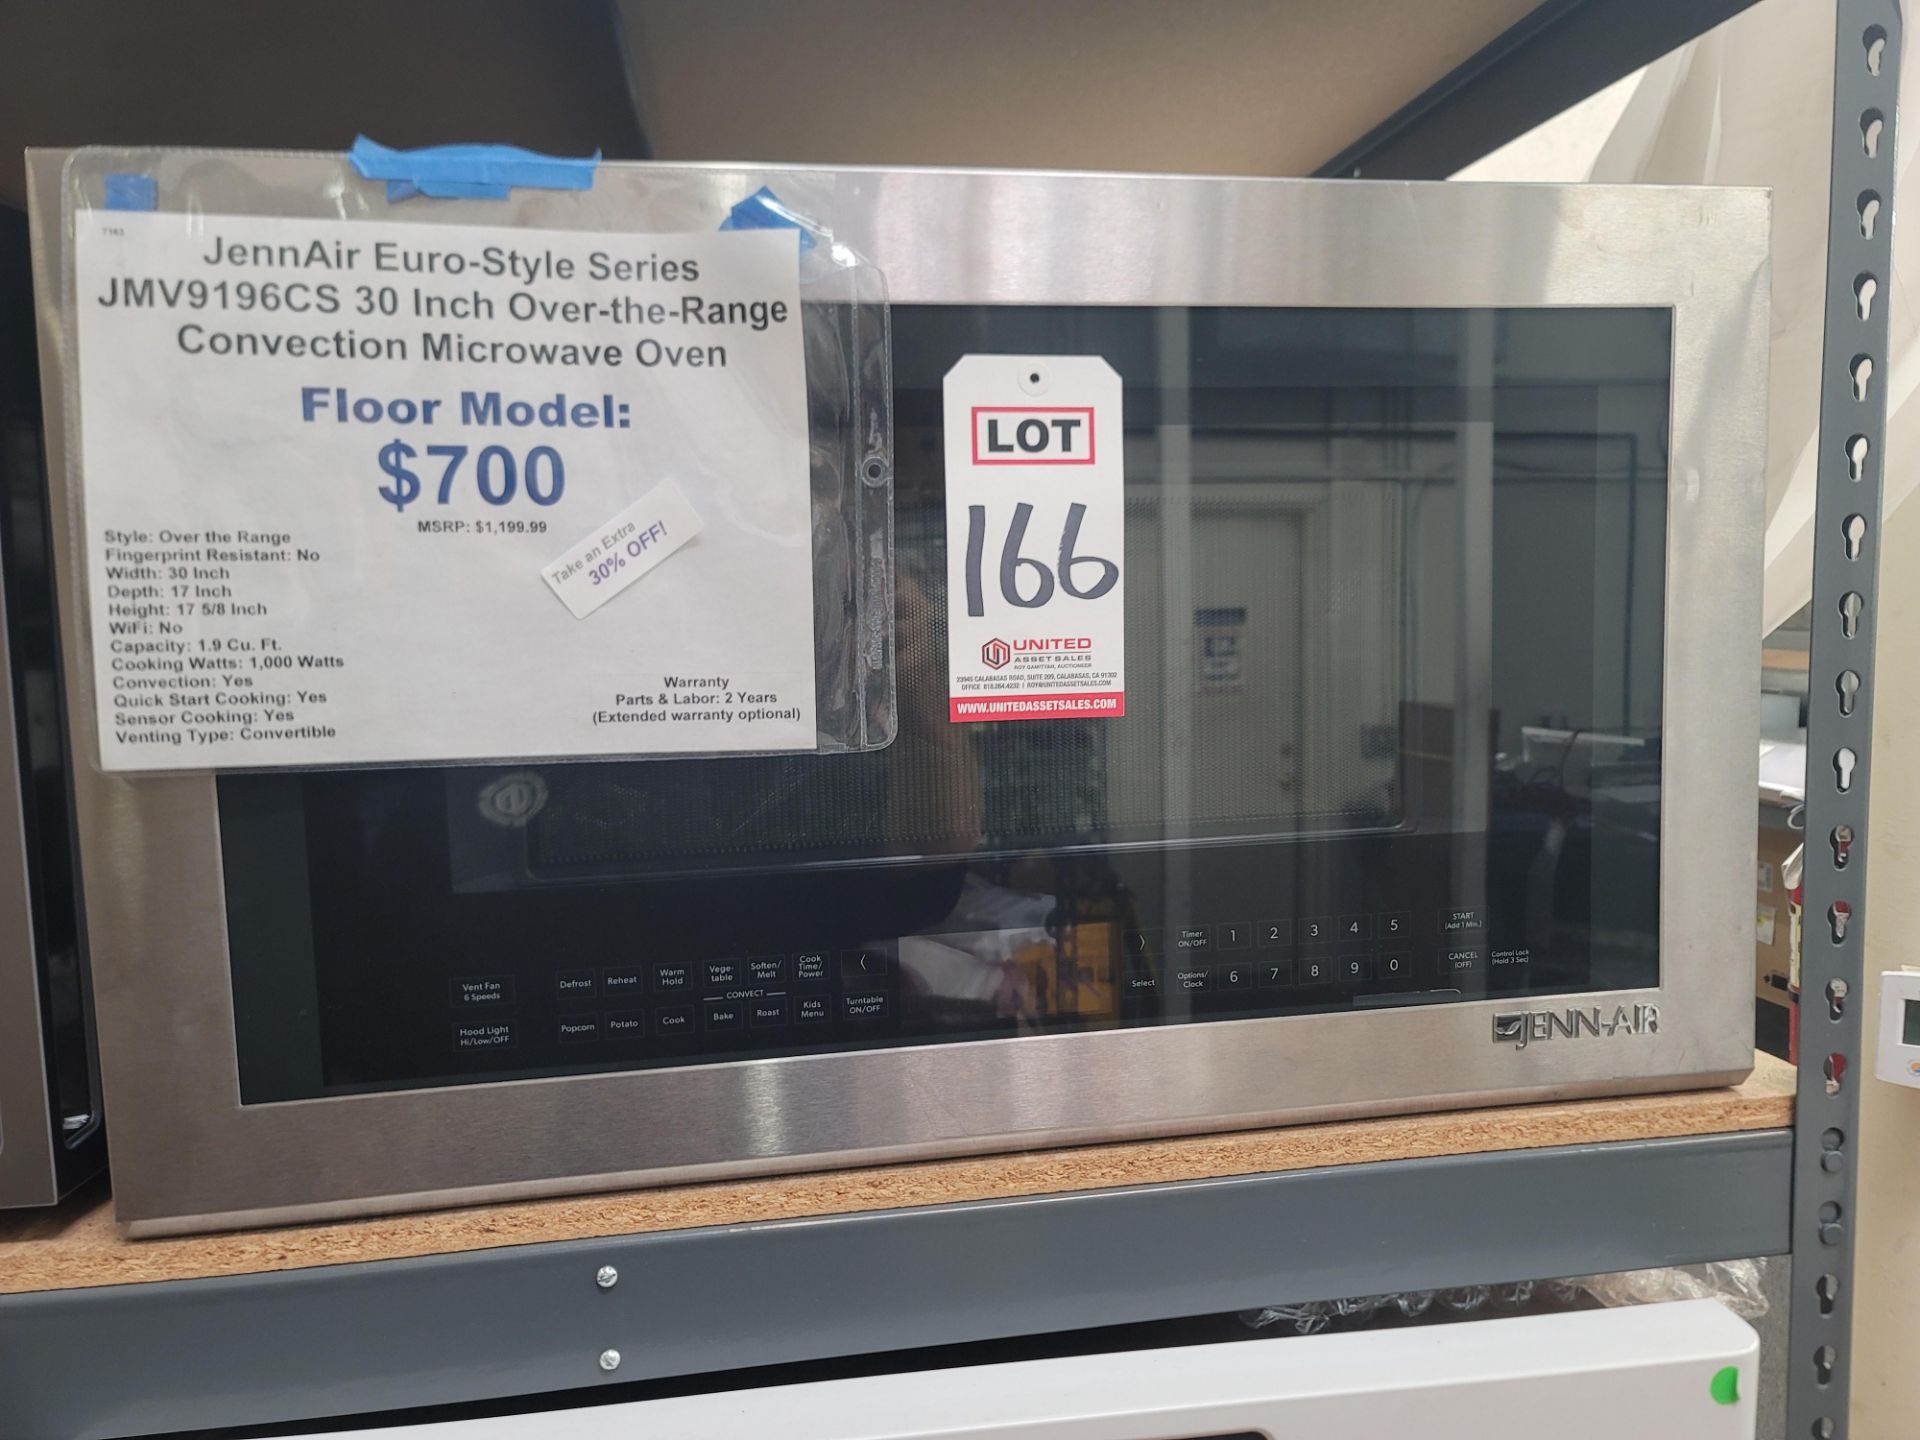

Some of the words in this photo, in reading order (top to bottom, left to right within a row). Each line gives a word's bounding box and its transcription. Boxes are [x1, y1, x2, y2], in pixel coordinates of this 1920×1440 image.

[203, 237, 361, 269] JennAir
[375, 242, 575, 285] Euro-Style
[589, 252, 700, 282] Series
[98, 277, 340, 313] JMV9196CS
[356, 286, 399, 316] 30
[413, 289, 494, 319] Inch
[509, 292, 788, 331] Over-the-Range
[178, 324, 407, 360] Convection
[422, 332, 622, 366] Microwave
[636, 339, 727, 367] Oven
[301, 387, 442, 425] Floor
[461, 391, 630, 429] Model:
[988, 418, 1081, 453] LOT
[378, 439, 565, 512] $700
[418, 520, 470, 533] MSRP:
[475, 520, 547, 535] $1,199.99
[104, 530, 152, 546] Style:
[159, 530, 200, 543] Over
[206, 531, 231, 543] the
[238, 531, 291, 546] Range
[105, 548, 200, 564] Fingerprint
[206, 549, 291, 562] Resistant:
[297, 550, 320, 562] No
[552, 560, 584, 584] Take
[585, 546, 602, 563] an
[601, 522, 636, 550] Extra
[589, 552, 626, 586] 30%
[627, 520, 668, 557] OFF!
[966, 502, 1119, 617] 166
[106, 567, 162, 580] Width:
[168, 567, 187, 579] 30
[193, 567, 230, 580] Inch
[107, 585, 163, 600] Depth:
[171, 585, 190, 598] 17
[195, 585, 232, 598] Inch
[108, 603, 170, 619] Height:
[177, 603, 195, 616] 17
[202, 603, 225, 616] 5/8
[231, 603, 267, 616] Inch
[109, 622, 153, 635] WiFi:
[159, 622, 183, 634] No
[111, 639, 191, 655] Capacity:
[198, 639, 221, 652] 1.9
[227, 638, 255, 651] Cu.
[261, 638, 282, 651] Ft.
[1014, 638, 1092, 651] UNITED
[112, 657, 183, 673] Cooking
[189, 657, 243, 670] Watts:
[250, 656, 292, 671] 1,000
[297, 655, 344, 668] Watts
[113, 675, 217, 689] Convection:
[222, 675, 253, 688] Yes
[1027, 673, 1043, 681] SUITE
[1056, 672, 1091, 680] CALABASAS,
[664, 676, 729, 690] Warranty
[114, 694, 163, 708] Quick
[169, 693, 210, 706] Start
[215, 692, 291, 708] Cooking:
[297, 691, 327, 704] Yes
[616, 694, 653, 706] Parts
[659, 693, 669, 705] &
[674, 693, 719, 705] Labor:
[725, 692, 733, 704] 2
[738, 692, 777, 704] Years
[957, 698, 1117, 715] WWW.UNITEDASSETSALES.COM
[115, 712, 175, 726] Sensor
[181, 710, 258, 726] Cooking:
[264, 709, 294, 722] Yes
[593, 710, 666, 726] (Extended
[671, 710, 734, 723] warranty
[738, 708, 801, 723] optional)
[116, 730, 181, 746] Venting
[187, 728, 234, 745] Type:
[240, 726, 336, 740] Convertible
[1453, 912, 1474, 920] START
[1310, 924, 1319, 936] 3
[1350, 922, 1359, 933] 4
[1390, 919, 1398, 931] 5
[1445, 922, 1460, 930] (Add
[1182, 930, 1203, 938] Timer
[1230, 930, 1236, 942] 1
[1270, 927, 1279, 939] 2
[1178, 939, 1207, 948] ON/OFF
[799, 954, 821, 963] Cook
[1448, 952, 1478, 960] CANCEL
[1491, 950, 1514, 958] Control
[751, 960, 782, 970] Soften/
[799, 961, 823, 972] Time/
[1390, 959, 1398, 971] 0
[1455, 961, 1472, 969] (OFF)
[1492, 957, 1509, 965] (Hold
[660, 968, 685, 977] Warm
[709, 965, 734, 976] Vege-
[798, 969, 824, 978] Power
[1270, 968, 1279, 980] 7
[1311, 965, 1319, 977] 8
[1350, 962, 1359, 974] 9
[607, 976, 637, 985] Reheat
[711, 973, 733, 982] table
[757, 970, 776, 979] Melt
[1177, 970, 1209, 981] Options/
[1230, 971, 1238, 983] 6
[462, 983, 483, 992] Vent
[485, 982, 501, 991] Fan
[560, 979, 592, 989] Defrost
[662, 978, 684, 986] Hold
[1132, 979, 1155, 987] Select
[1183, 979, 1204, 988] Clock
[464, 993, 470, 1001] 6
[471, 992, 500, 1002] Speeds
[726, 990, 764, 999] CONVECT
[846, 995, 884, 1005] Turntable
[803, 1001, 821, 1009] Kids
[849, 1005, 881, 1014] ON/OFF
[713, 1012, 734, 1021] Bake
[757, 1008, 780, 1017] Roast
[801, 1009, 824, 1018] Menu
[610, 1019, 639, 1029] Potato
[662, 1016, 685, 1025] Cook
[460, 1027, 485, 1036] Hood
[487, 1025, 509, 1037] Light
[561, 1023, 595, 1033] Popcorn
[1516, 1004, 1661, 1050] JENN-AIR
[460, 1036, 510, 1047] Hi/Low/OFF
